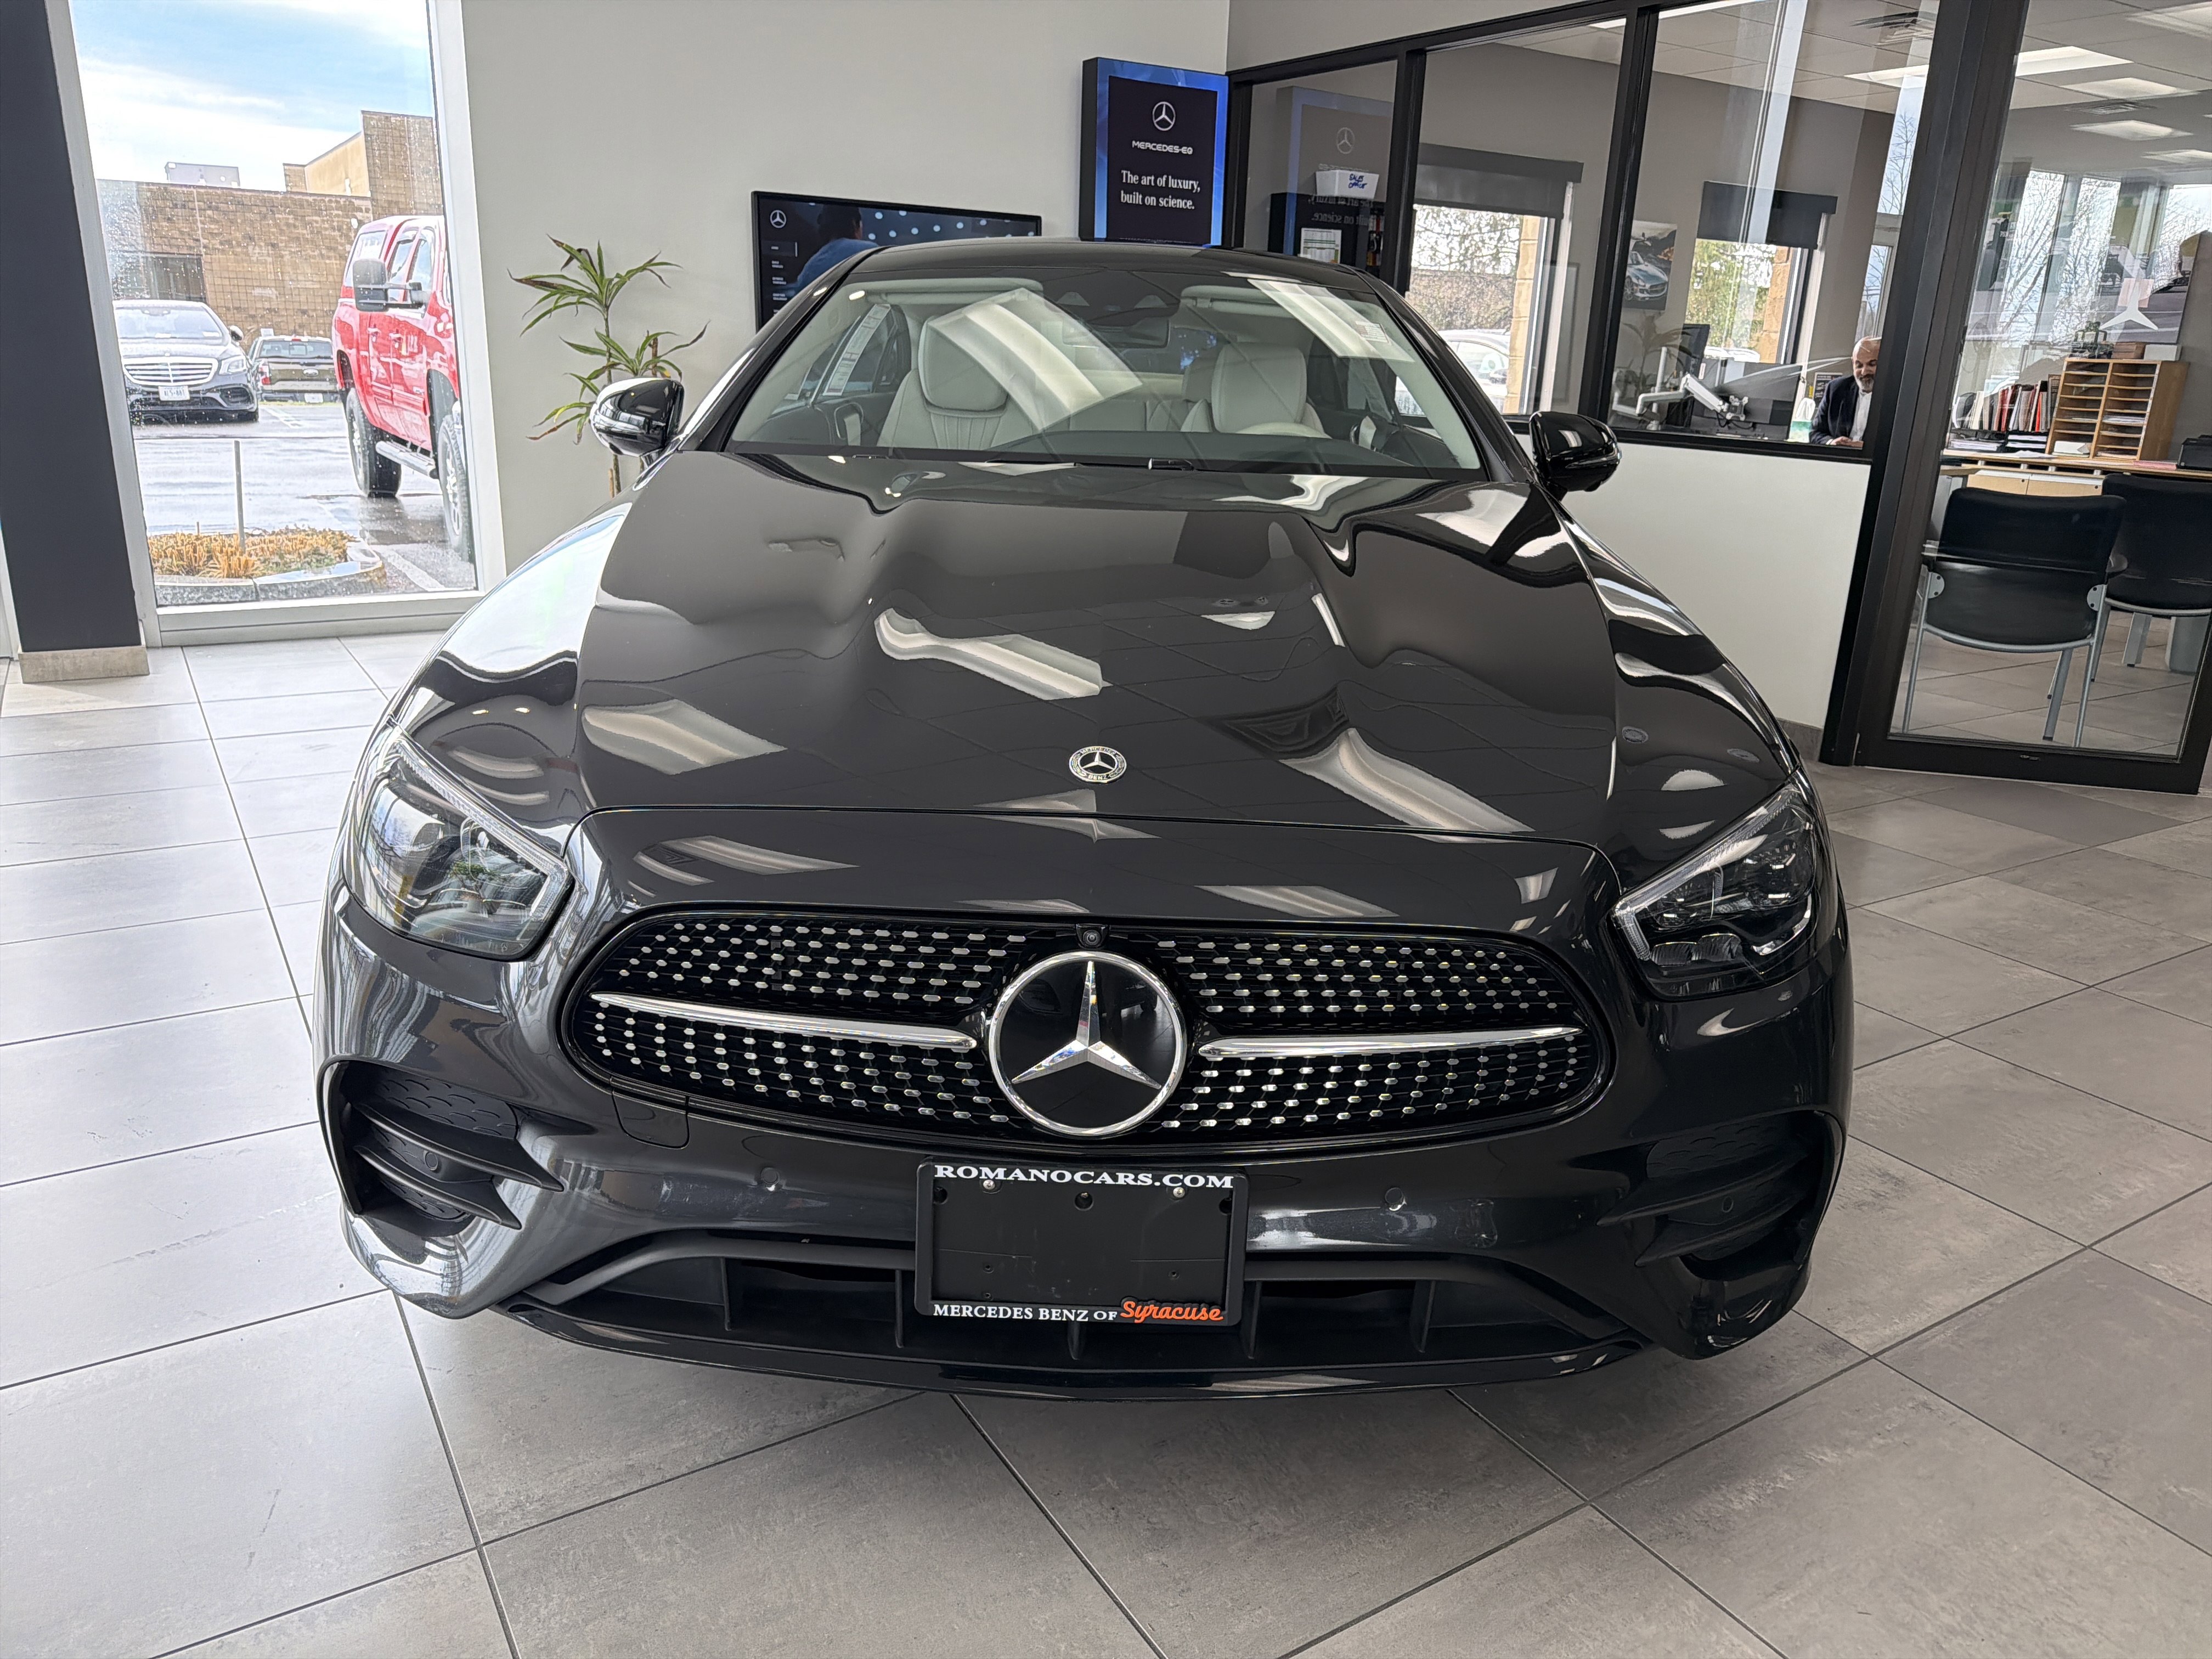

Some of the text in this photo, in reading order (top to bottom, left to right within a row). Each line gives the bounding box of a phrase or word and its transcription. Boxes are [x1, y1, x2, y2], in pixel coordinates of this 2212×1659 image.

[1132, 140, 1193, 155] MERCEDES-EQ
[1121, 170, 1200, 193] The art of luxury,
[1121, 190, 1195, 210] built on science.
[934, 1165, 1234, 1188] ROMANOCARS.COM
[934, 1301, 1224, 1323] MERCEDES BENZ OF Syracuse
